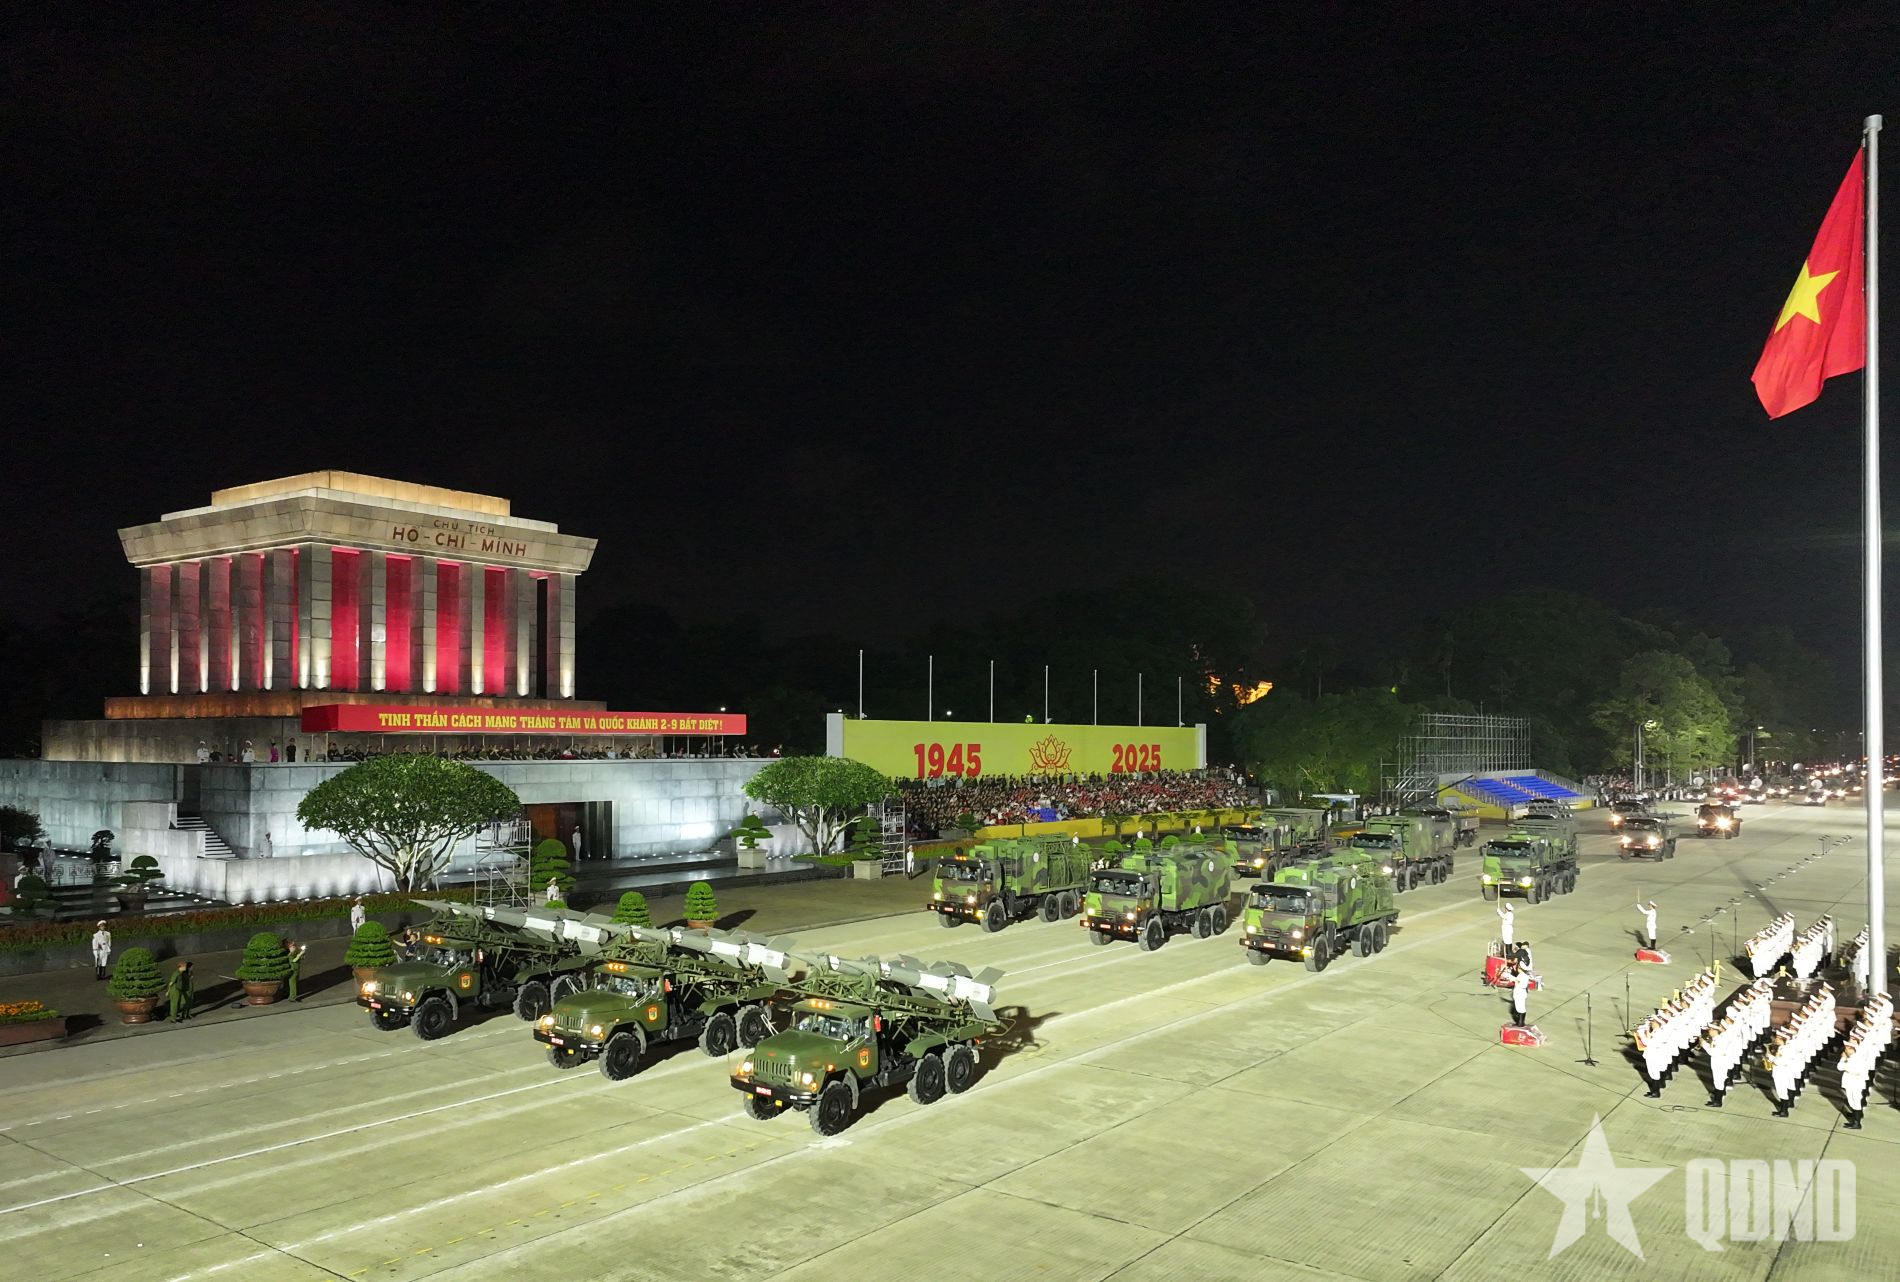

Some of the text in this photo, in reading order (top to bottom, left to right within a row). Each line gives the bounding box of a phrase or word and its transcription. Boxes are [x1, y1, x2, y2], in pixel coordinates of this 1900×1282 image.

[379, 713, 411, 727] TINH
[451, 713, 482, 727] CÁCH
[485, 715, 517, 730] MẠNG
[520, 715, 556, 729] THÁNG
[559, 715, 581, 729] TÁM
[584, 715, 597, 729] VÀ
[599, 715, 624, 730] QUỐC
[627, 717, 658, 730] KHÁNH
[680, 717, 697, 730] BẤT
[914, 742, 982, 780] 1945
[1111, 743, 1161, 773] 2025
